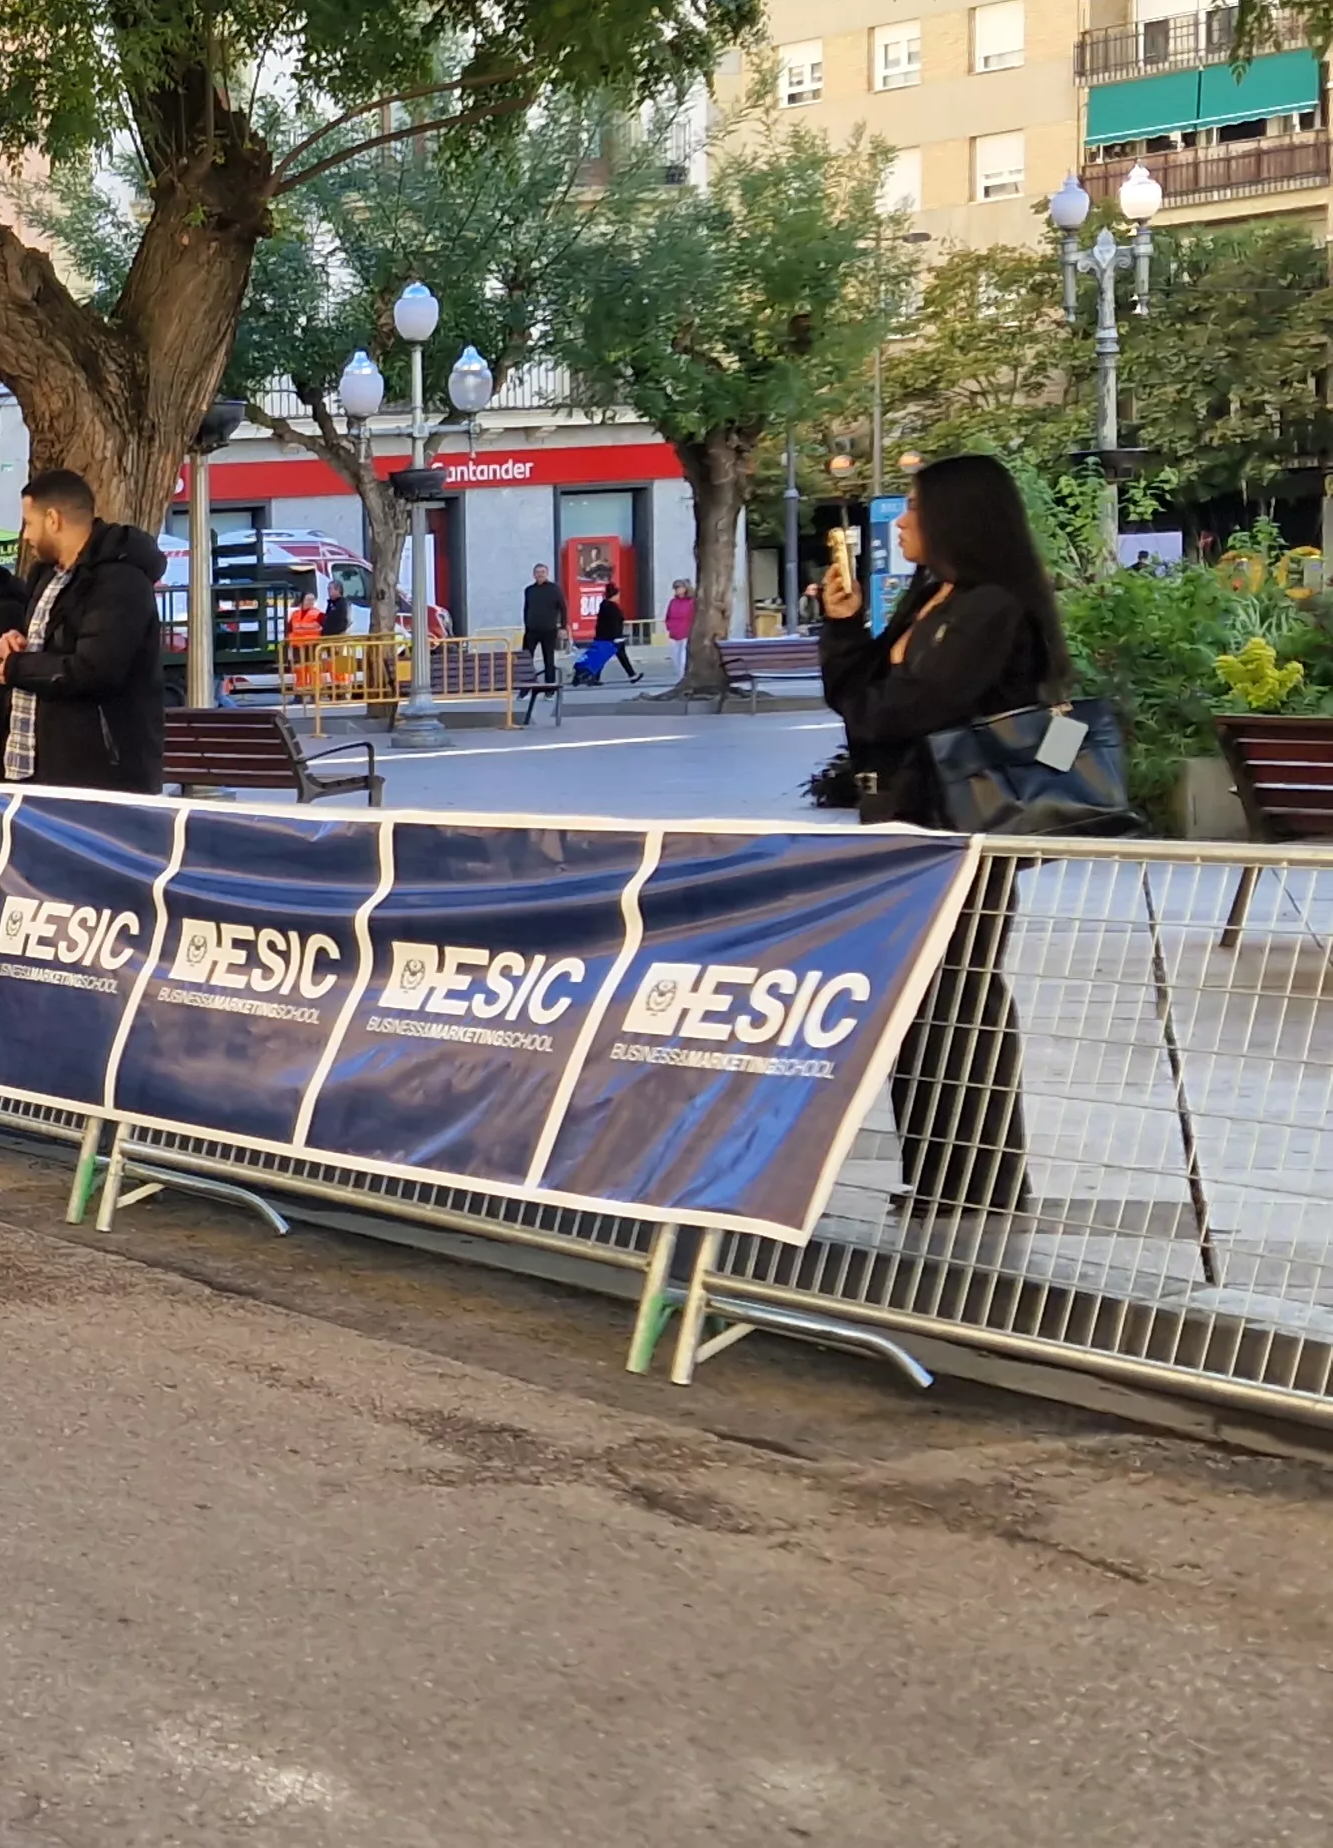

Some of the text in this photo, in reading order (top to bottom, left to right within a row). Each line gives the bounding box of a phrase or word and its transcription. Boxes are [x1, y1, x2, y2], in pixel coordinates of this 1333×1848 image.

[25, 901, 140, 970] ESIC
[209, 922, 341, 999] ESIC
[425, 945, 586, 1025] ESIC
[678, 964, 871, 1049] ESIC
